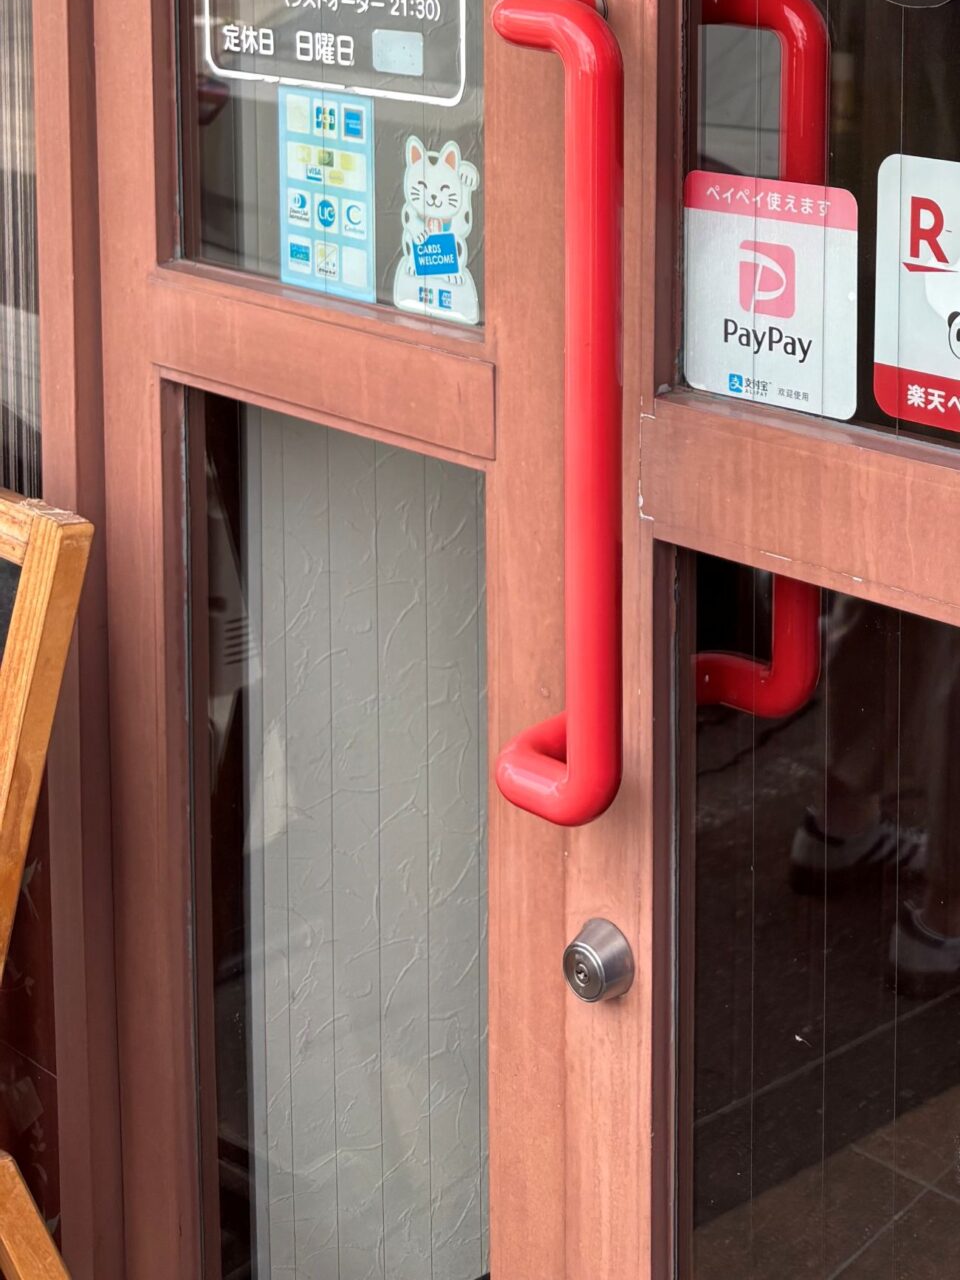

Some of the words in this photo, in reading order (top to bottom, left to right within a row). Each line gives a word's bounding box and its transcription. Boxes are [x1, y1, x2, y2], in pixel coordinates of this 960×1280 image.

[222, 24, 275, 56] 定休日
[295, 30, 355, 67] 日曜日
[706, 184, 832, 217] ペイペイ使えます
[908, 195, 951, 267] R
[417, 243, 442, 255] CARDS
[418, 254, 455, 266] WELCOME
[722, 318, 813, 364] PayPay
[744, 377, 769, 393] 支付宝
[777, 387, 810, 402] 欢迎使用
[744, 388, 768, 399] ALIPAY
